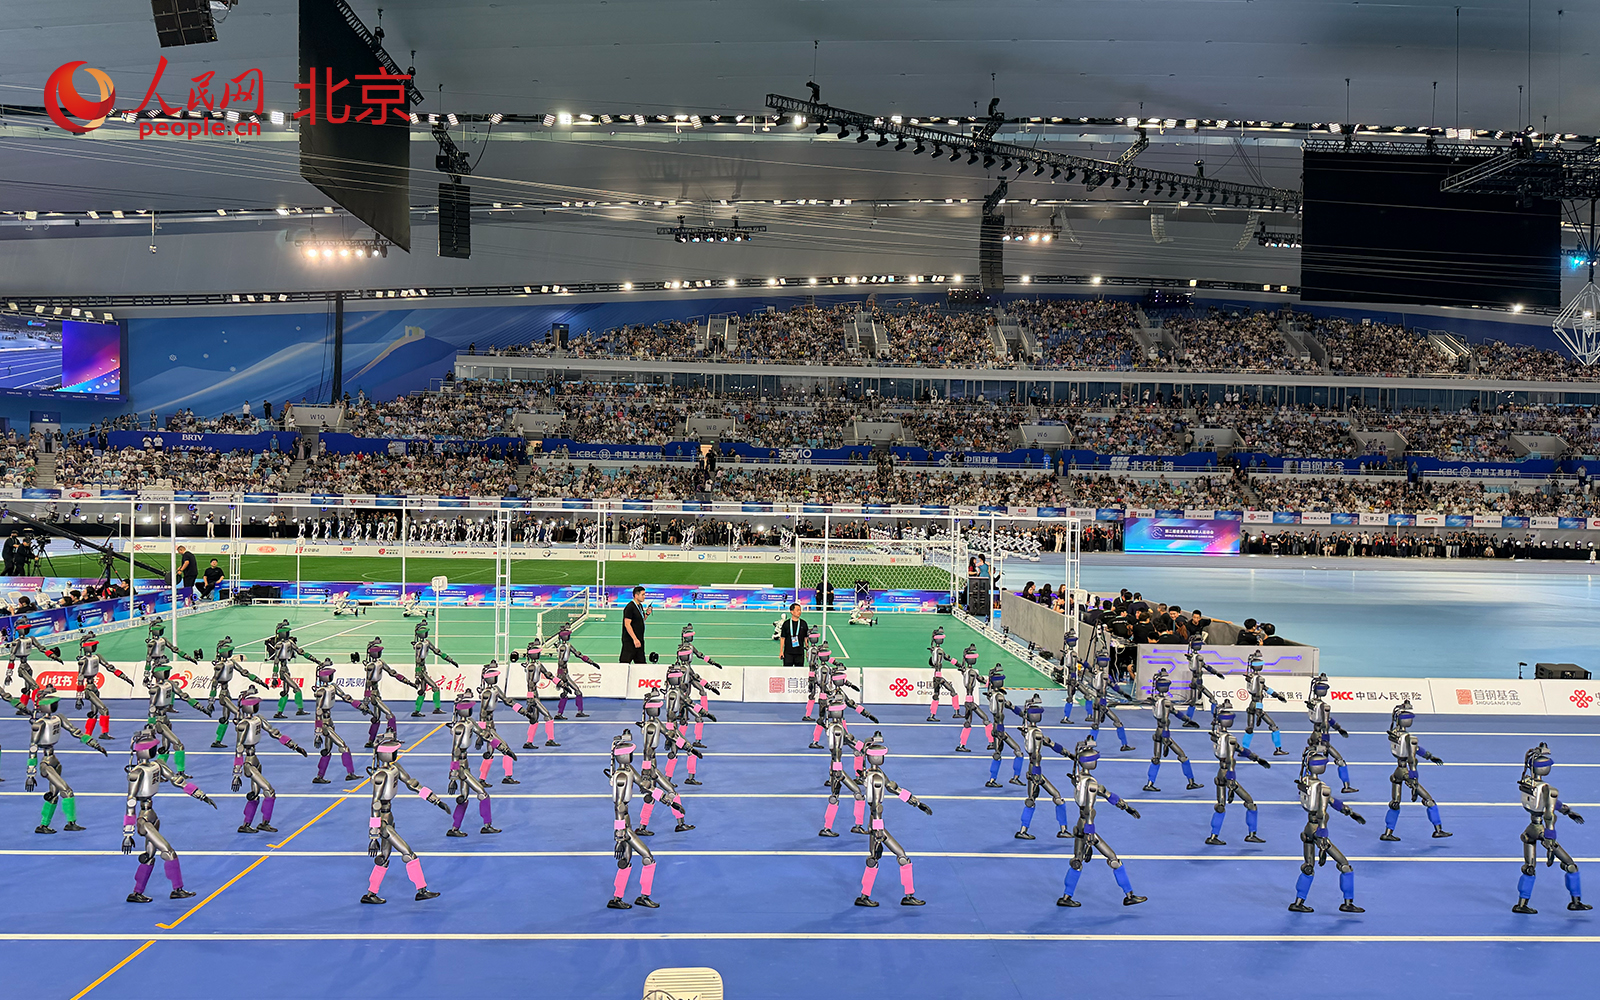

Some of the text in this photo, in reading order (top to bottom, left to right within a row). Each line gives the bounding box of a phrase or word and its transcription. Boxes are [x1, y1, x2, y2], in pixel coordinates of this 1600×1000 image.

[614, 451, 662, 460] 中国工商银行
[1475, 468, 1520, 477] 中国工商银行
[41, 675, 73, 687] 小红书
[638, 679, 662, 688] PICC
[1331, 691, 1422, 700] PICC 中国人民保险
[1474, 689, 1520, 701] 首钢基金
